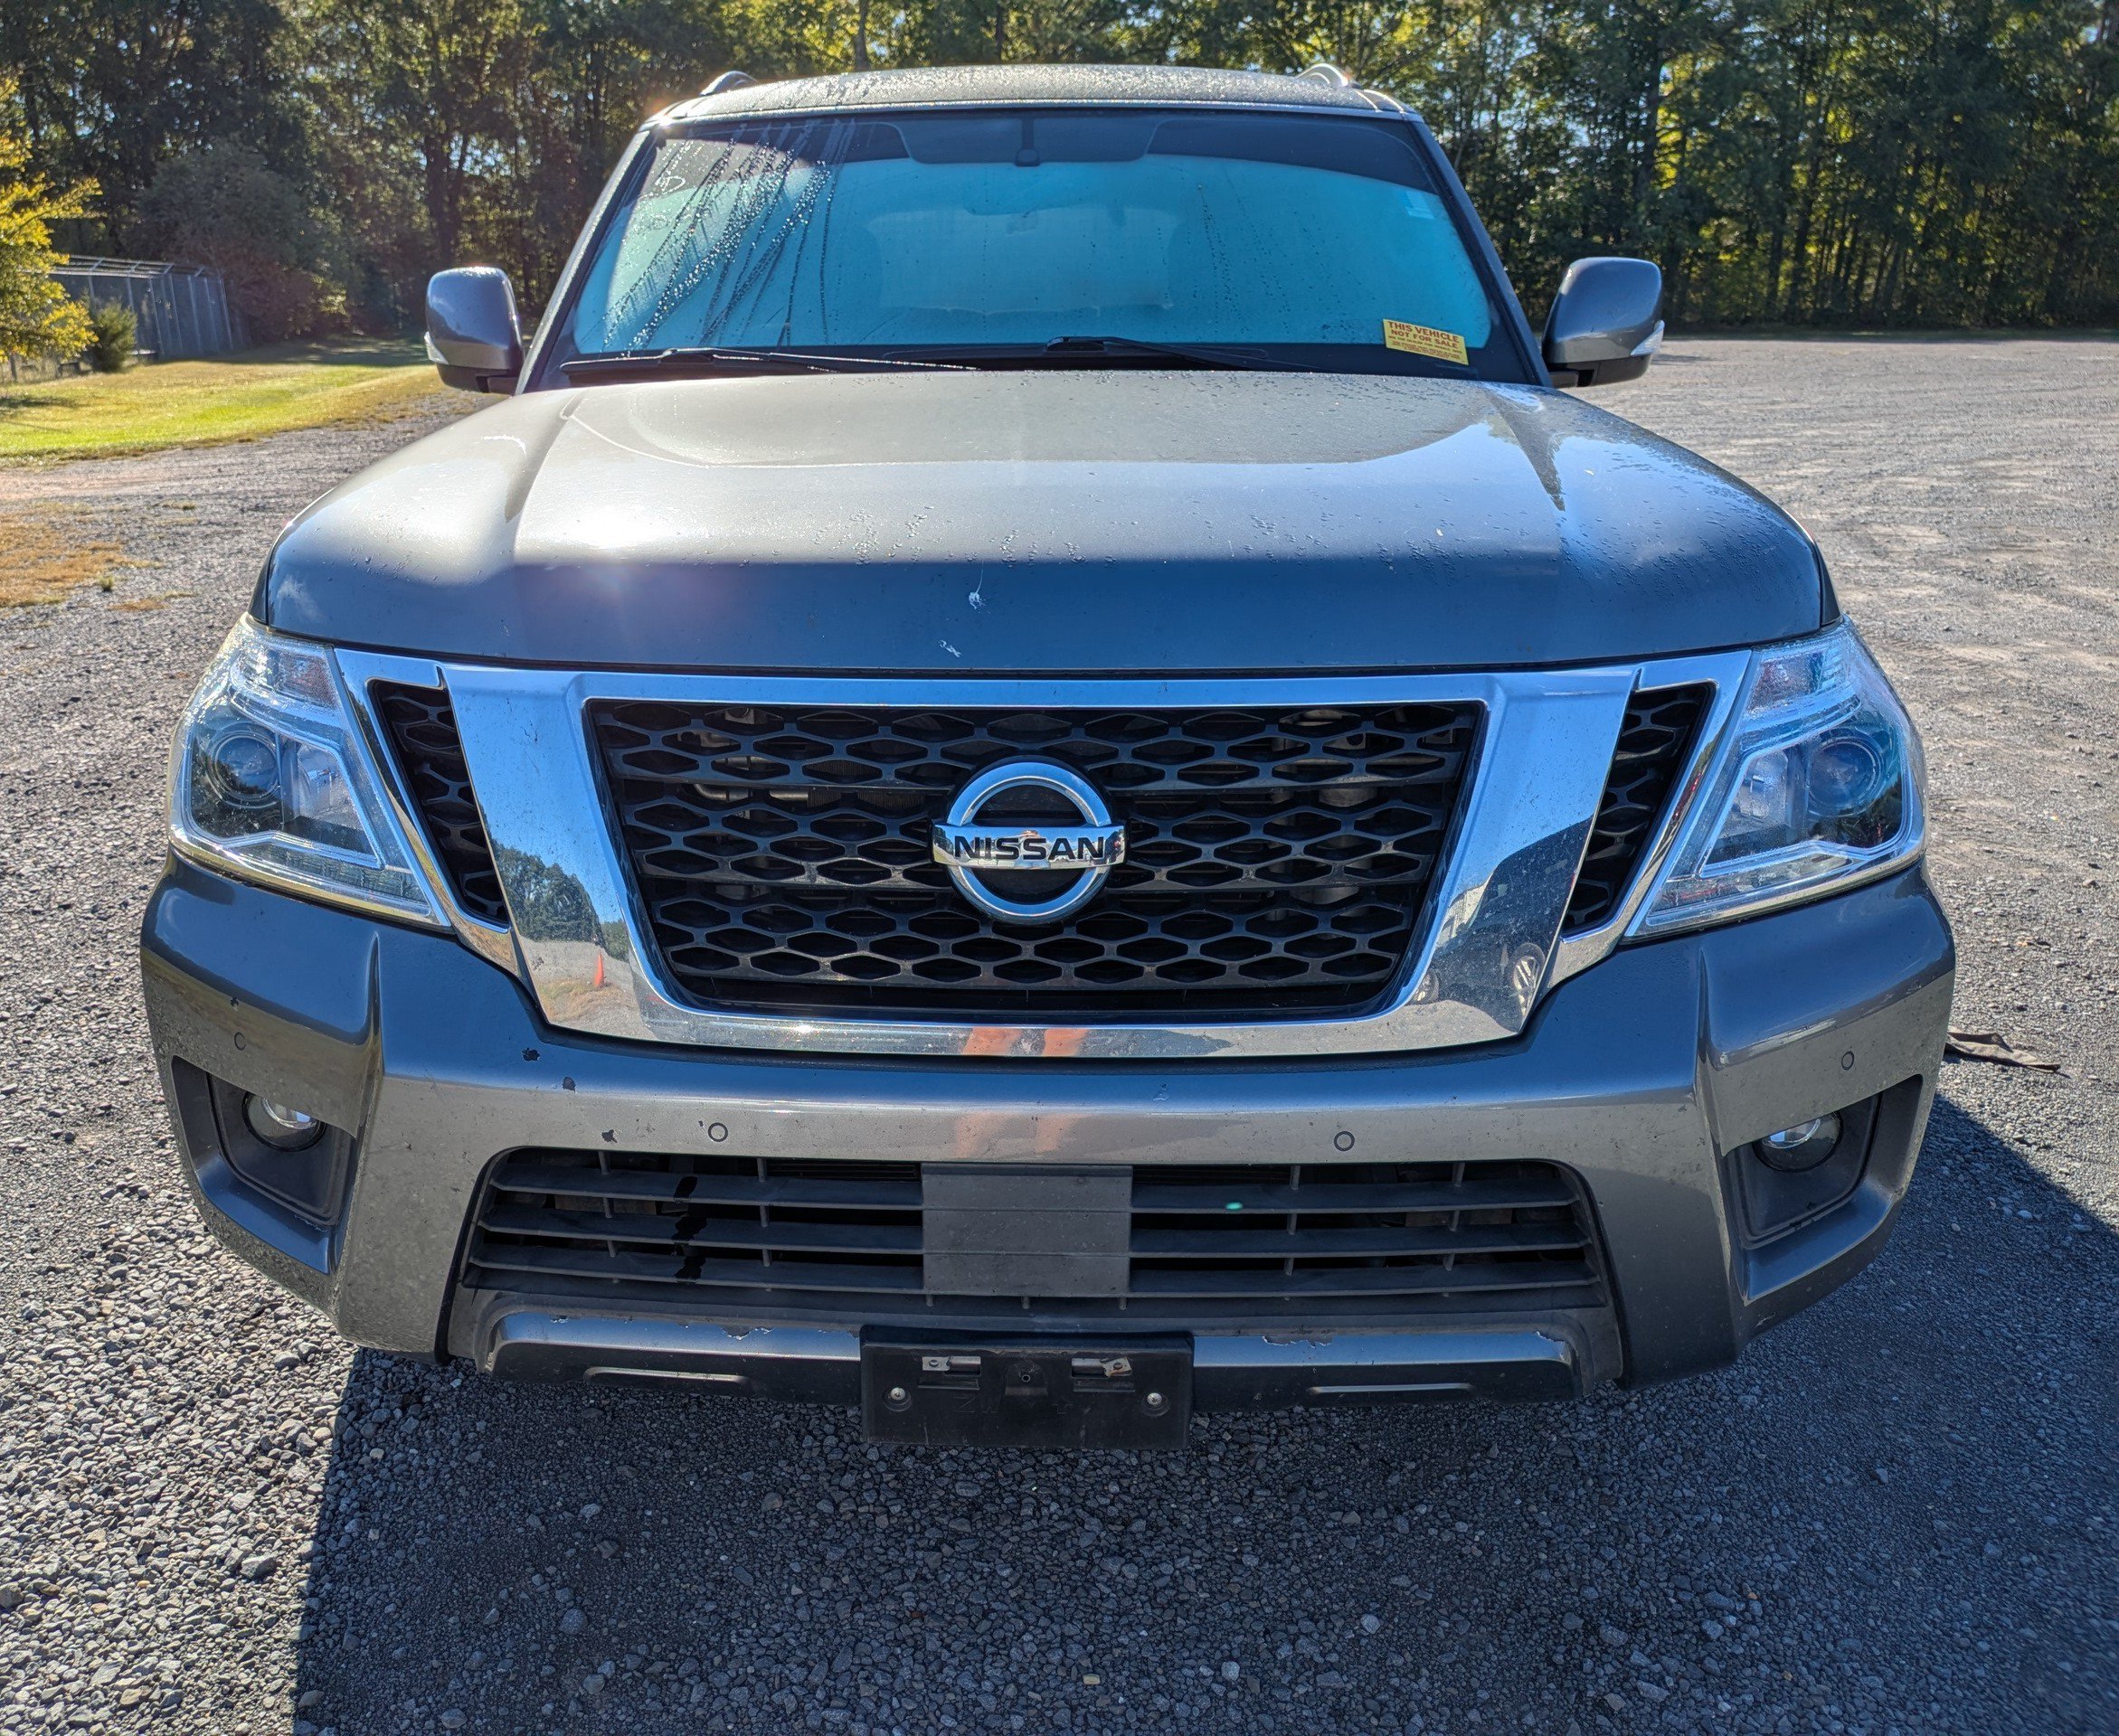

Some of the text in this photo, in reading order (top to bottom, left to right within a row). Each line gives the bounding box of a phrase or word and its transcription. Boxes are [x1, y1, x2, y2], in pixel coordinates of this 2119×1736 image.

[1387, 321, 1460, 344] THIS VEHICLE
[1391, 329, 1410, 337] NOT
[1413, 334, 1432, 342] FOR
[1434, 338, 1459, 349] SALE
[954, 835, 1104, 860] NISSAN
